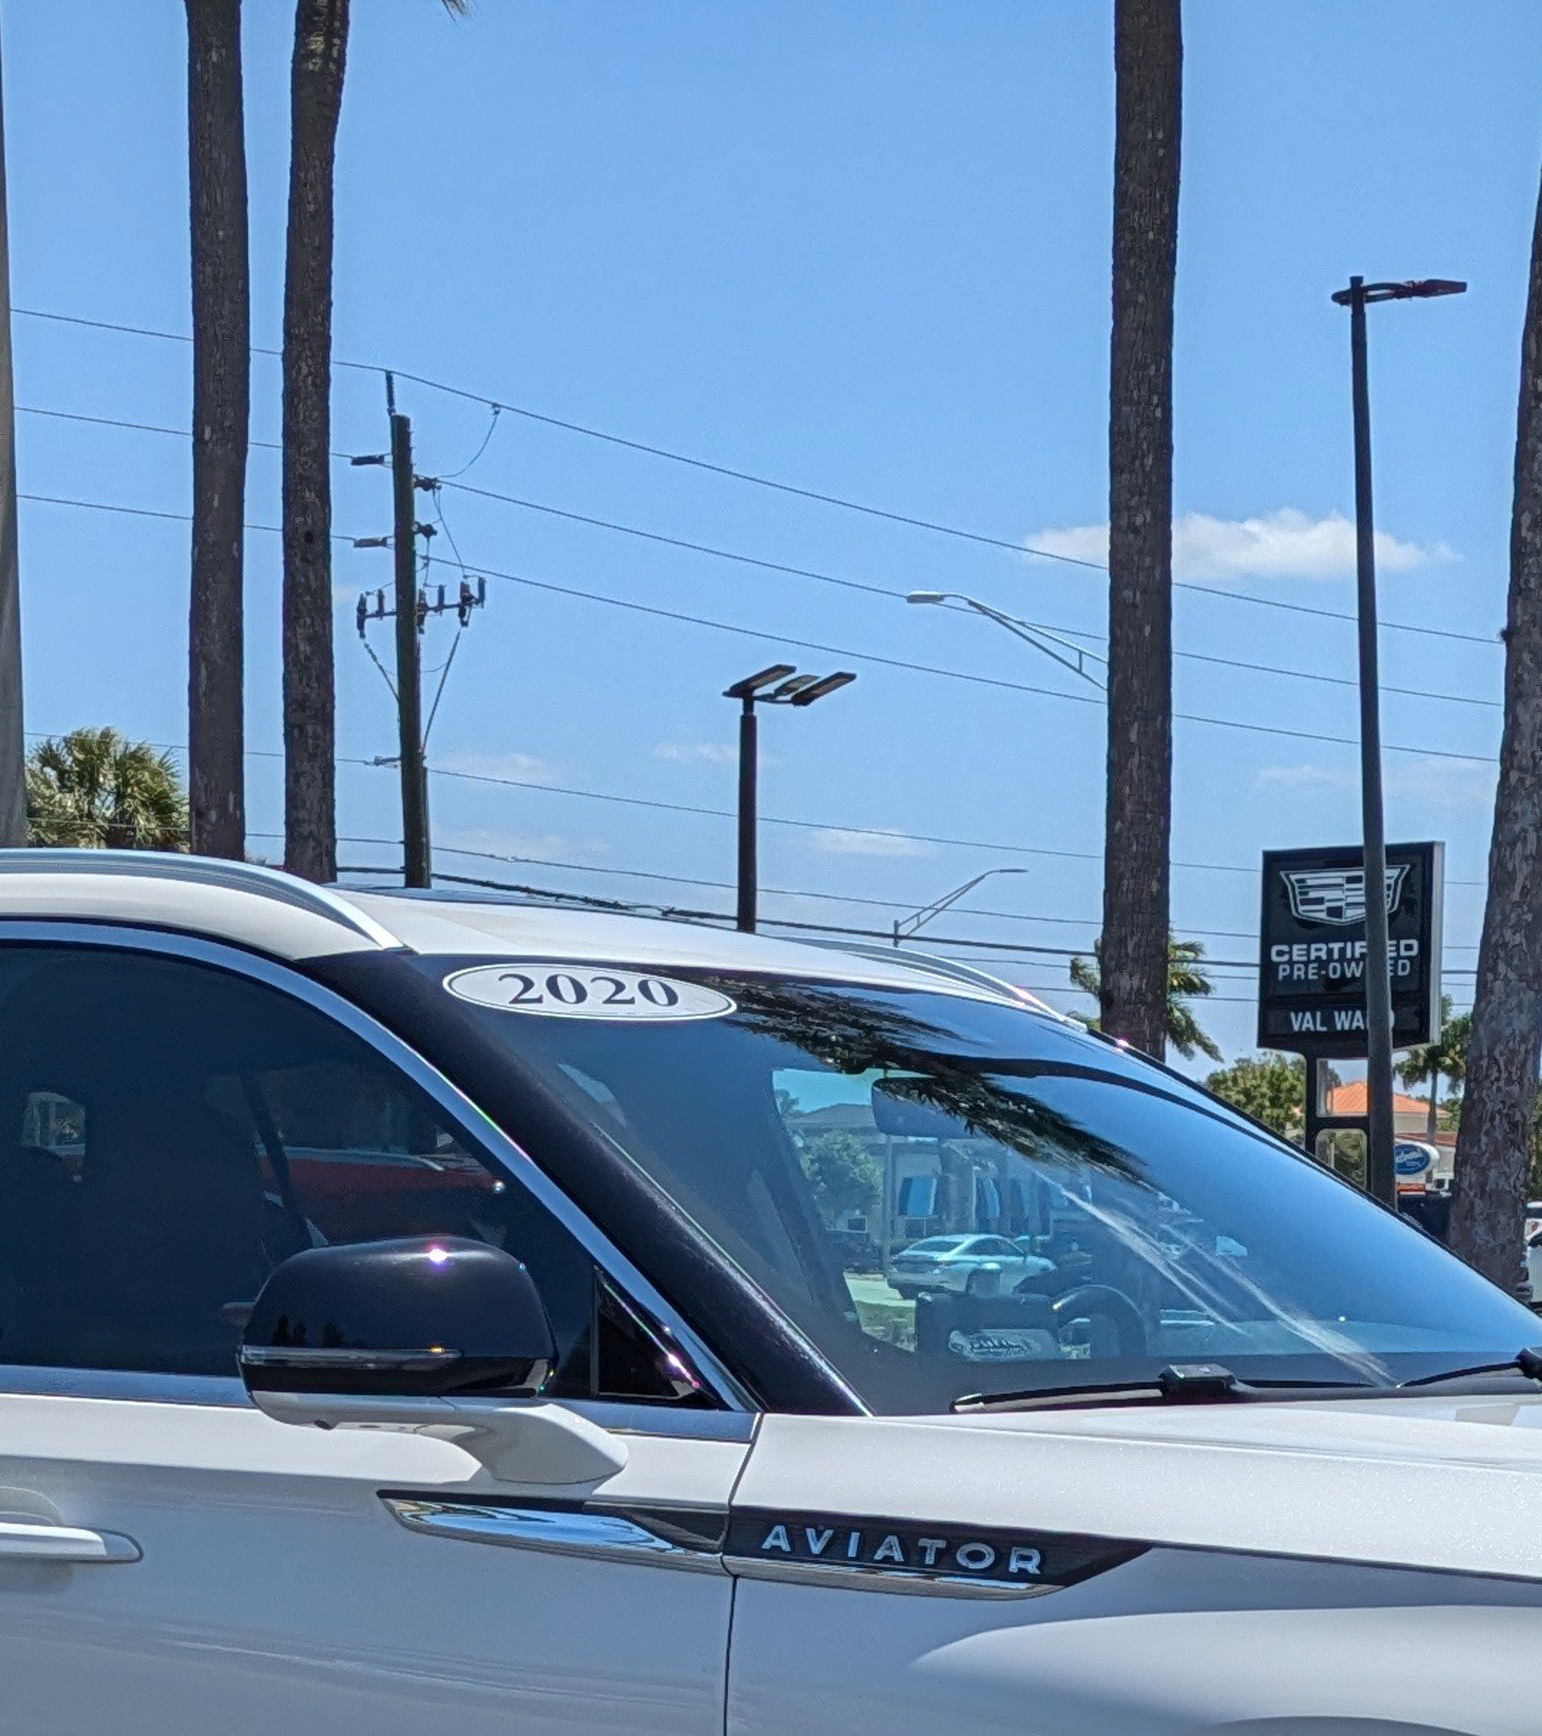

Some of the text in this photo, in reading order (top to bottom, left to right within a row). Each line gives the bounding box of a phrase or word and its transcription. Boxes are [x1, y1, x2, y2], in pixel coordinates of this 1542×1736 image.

[1270, 939, 1419, 963] CERTIFED
[1278, 959, 1411, 981] PRE-OWED
[497, 973, 679, 1007] 2020
[1289, 1009, 1395, 1032] VAL WA
[761, 1525, 1042, 1575] AVIATOR
